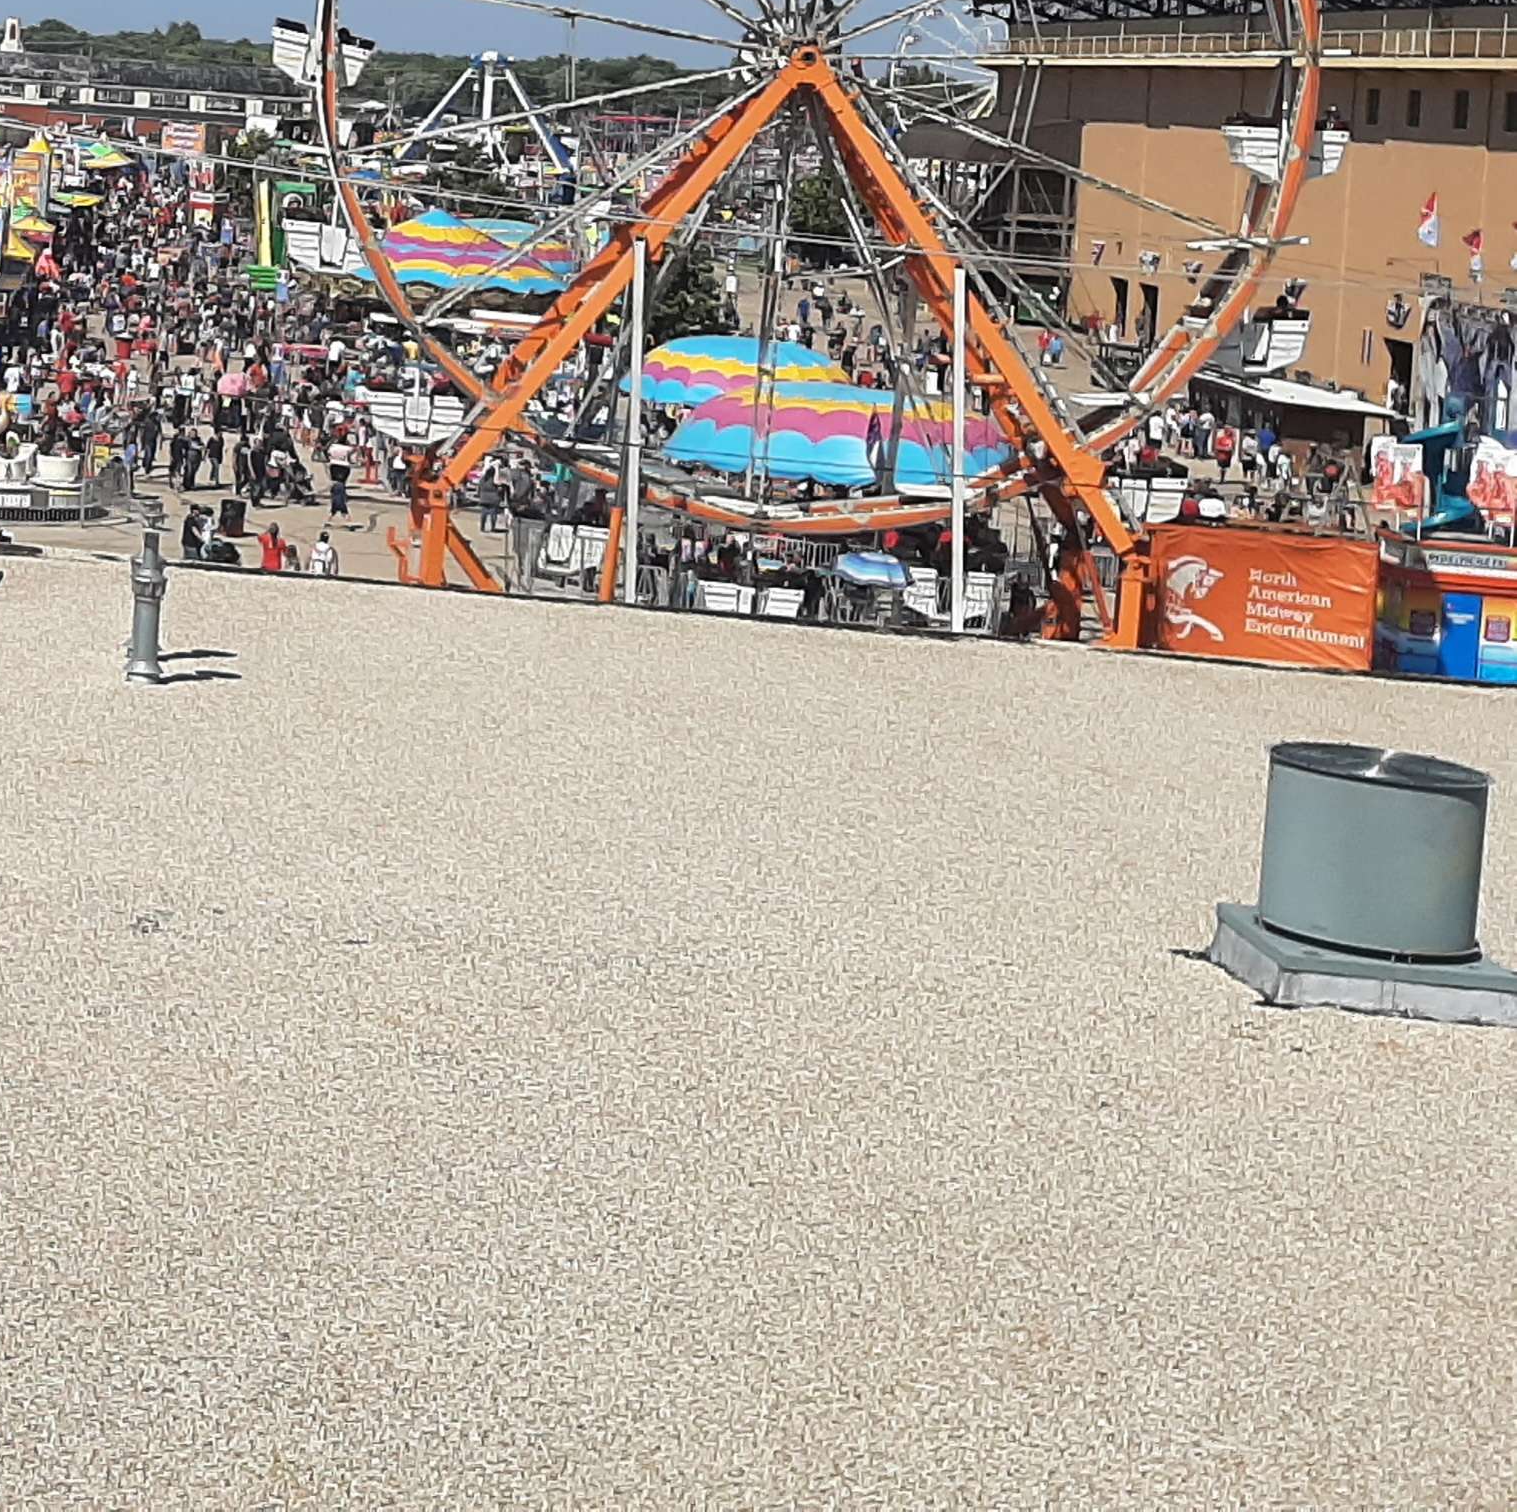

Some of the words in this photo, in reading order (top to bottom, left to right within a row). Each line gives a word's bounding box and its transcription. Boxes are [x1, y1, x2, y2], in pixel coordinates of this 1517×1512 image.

[1248, 568, 1298, 587] North
[1247, 585, 1332, 608] American
[1246, 601, 1314, 624] Midway
[1244, 618, 1365, 649] Entertainment
